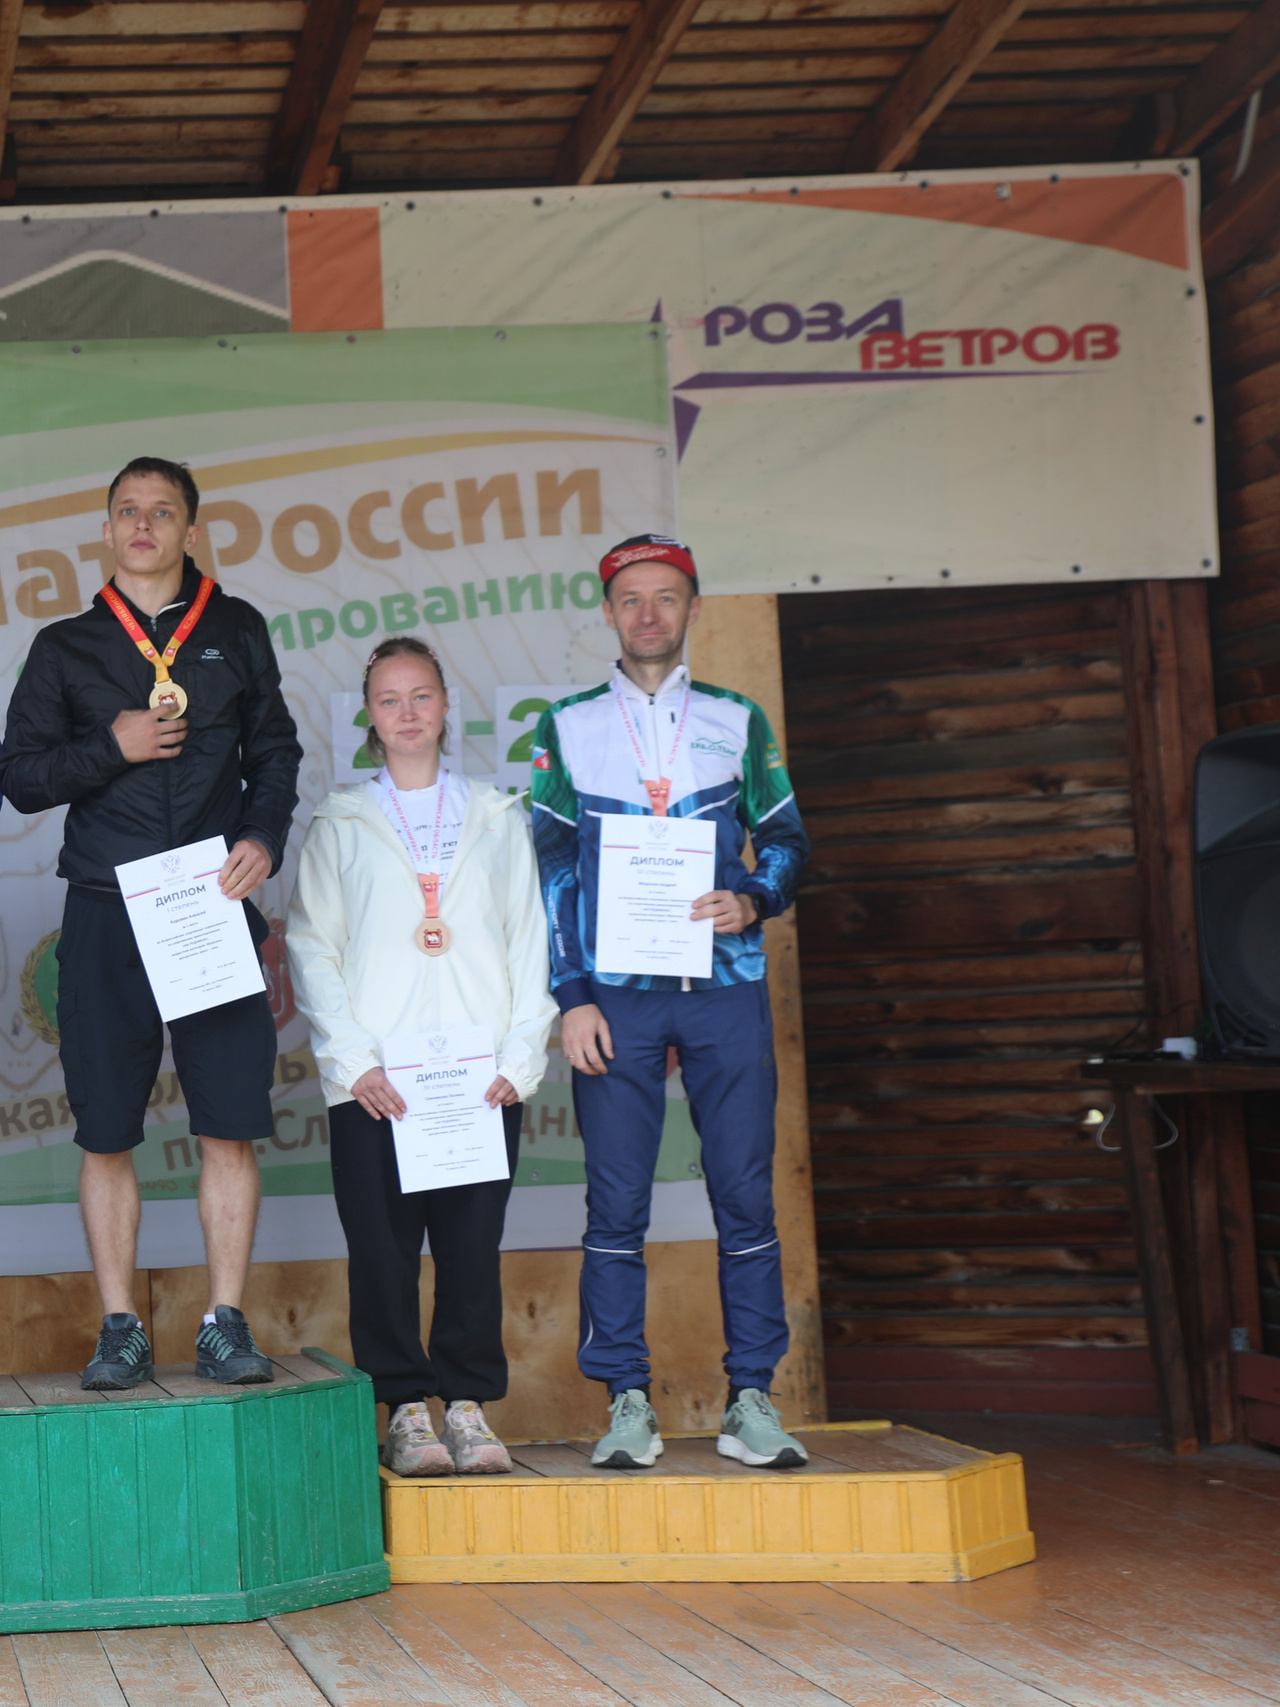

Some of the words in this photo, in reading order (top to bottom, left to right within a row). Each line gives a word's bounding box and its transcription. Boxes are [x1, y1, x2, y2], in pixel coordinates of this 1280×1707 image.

[705, 299, 904, 347] РОЗА
[861, 324, 1120, 371] ВЕТРОВ
[630, 856, 685, 867] ДИПЛОМ
[155, 884, 207, 908] ДИПЛОМ
[416, 1068, 468, 1083] ДИПЛОМ
